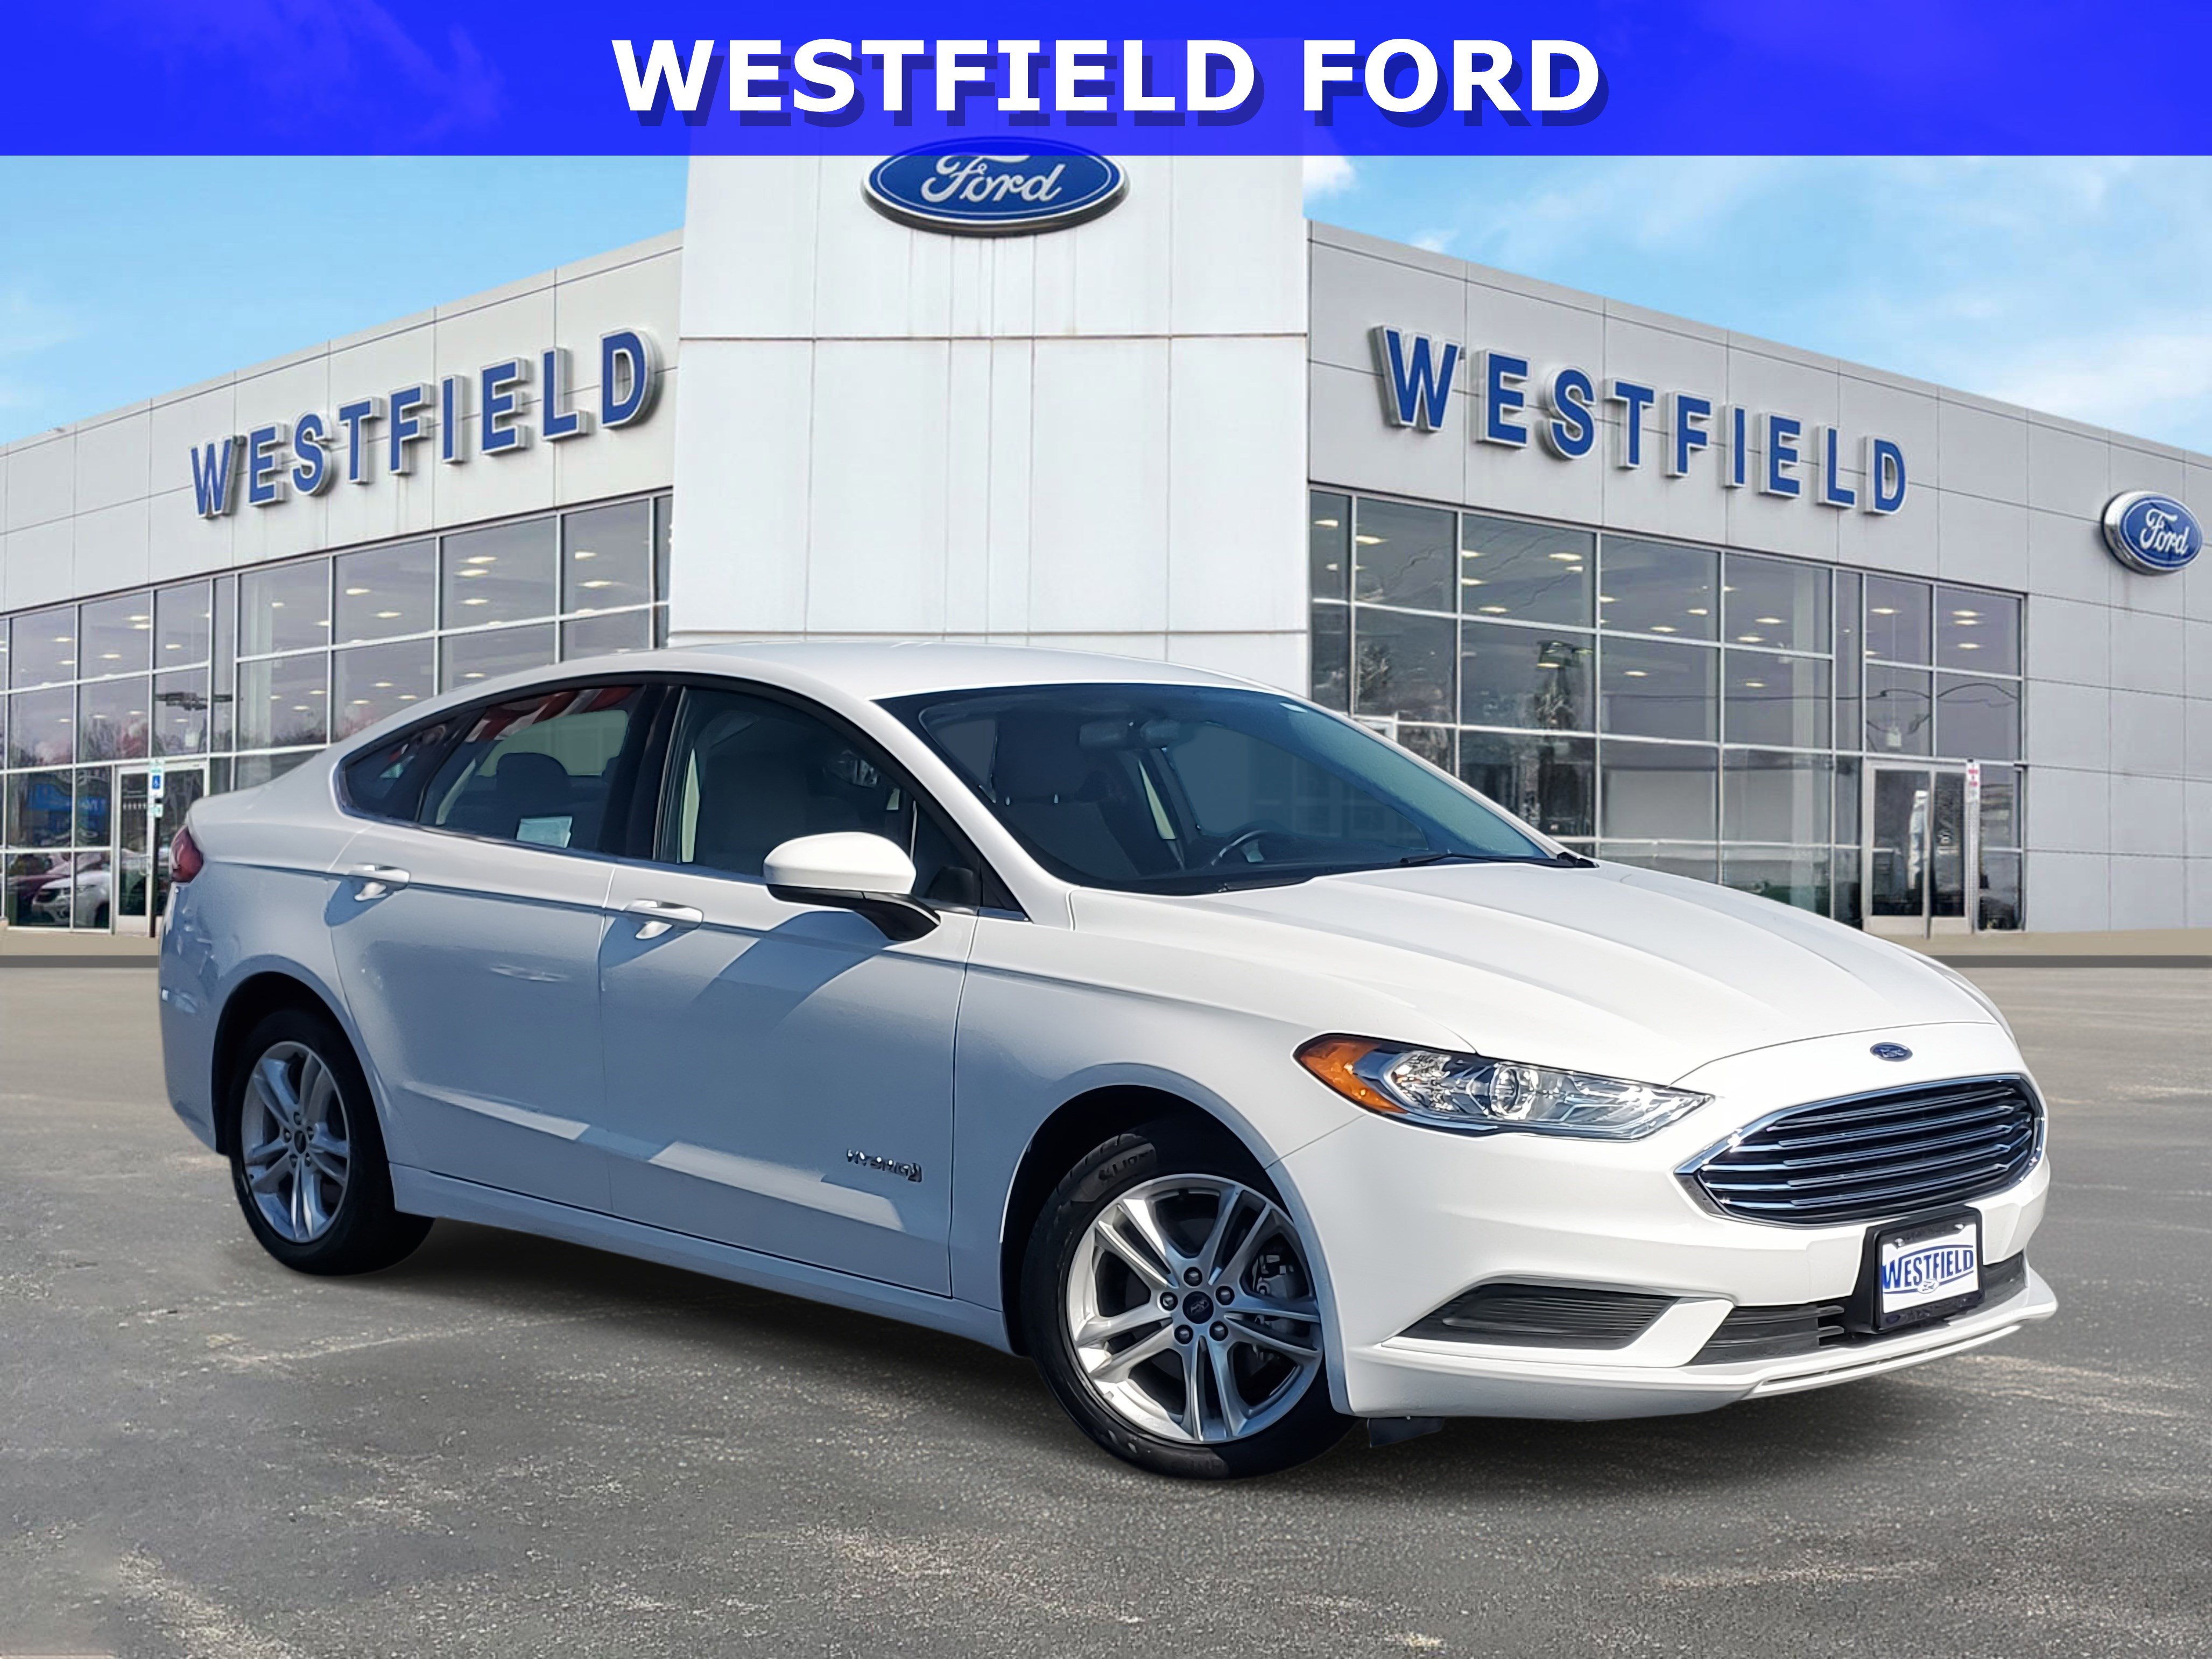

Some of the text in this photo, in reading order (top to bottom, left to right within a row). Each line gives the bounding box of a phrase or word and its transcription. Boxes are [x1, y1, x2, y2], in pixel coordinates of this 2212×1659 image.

[921, 151, 1066, 202] Ford
[191, 329, 656, 519] WESTFIELD
[1372, 324, 1907, 516] WESTFIELD
[2140, 509, 2190, 555] Ford
[1882, 1249, 1974, 1289] WESTFIELD
